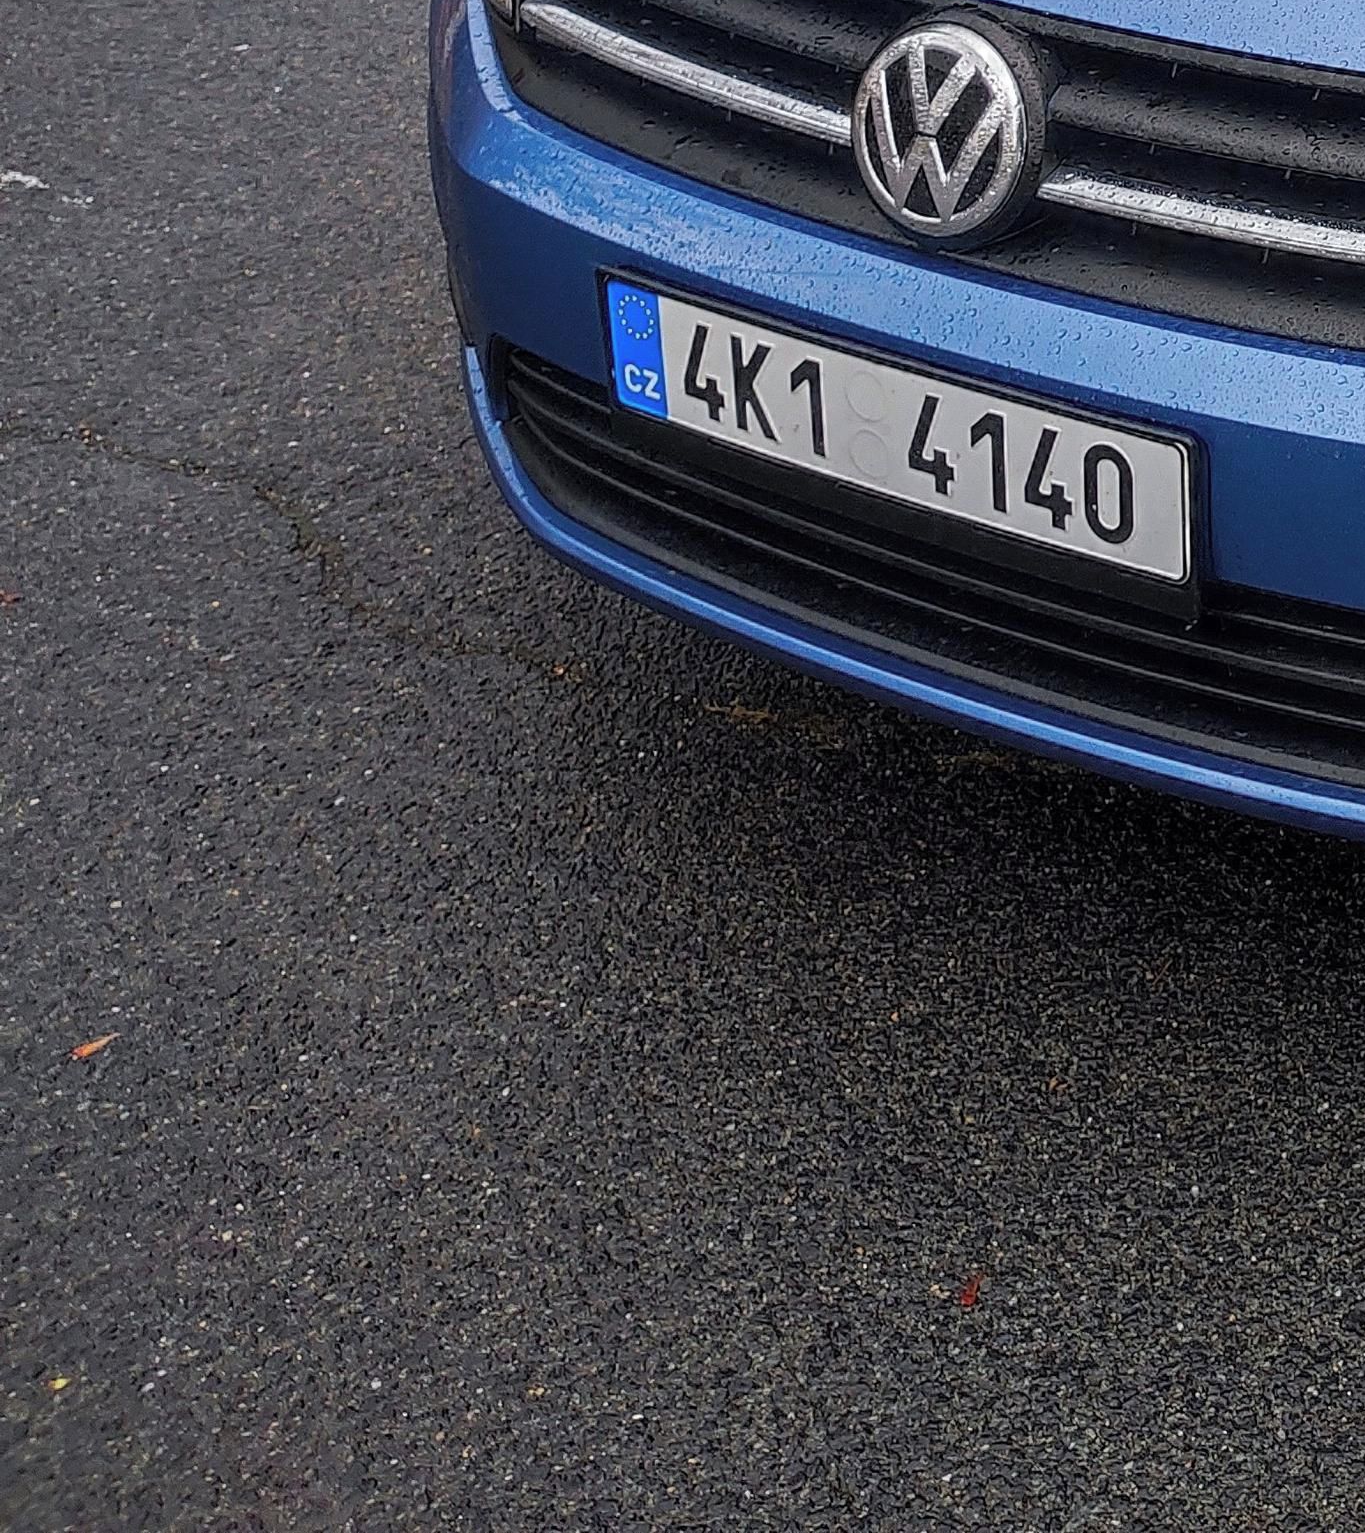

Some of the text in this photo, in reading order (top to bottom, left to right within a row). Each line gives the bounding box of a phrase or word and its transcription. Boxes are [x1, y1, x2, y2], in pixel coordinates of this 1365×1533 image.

[866, 36, 1006, 225] VW
[623, 361, 662, 401] CZ
[683, 323, 1136, 545] 4K1 4140
